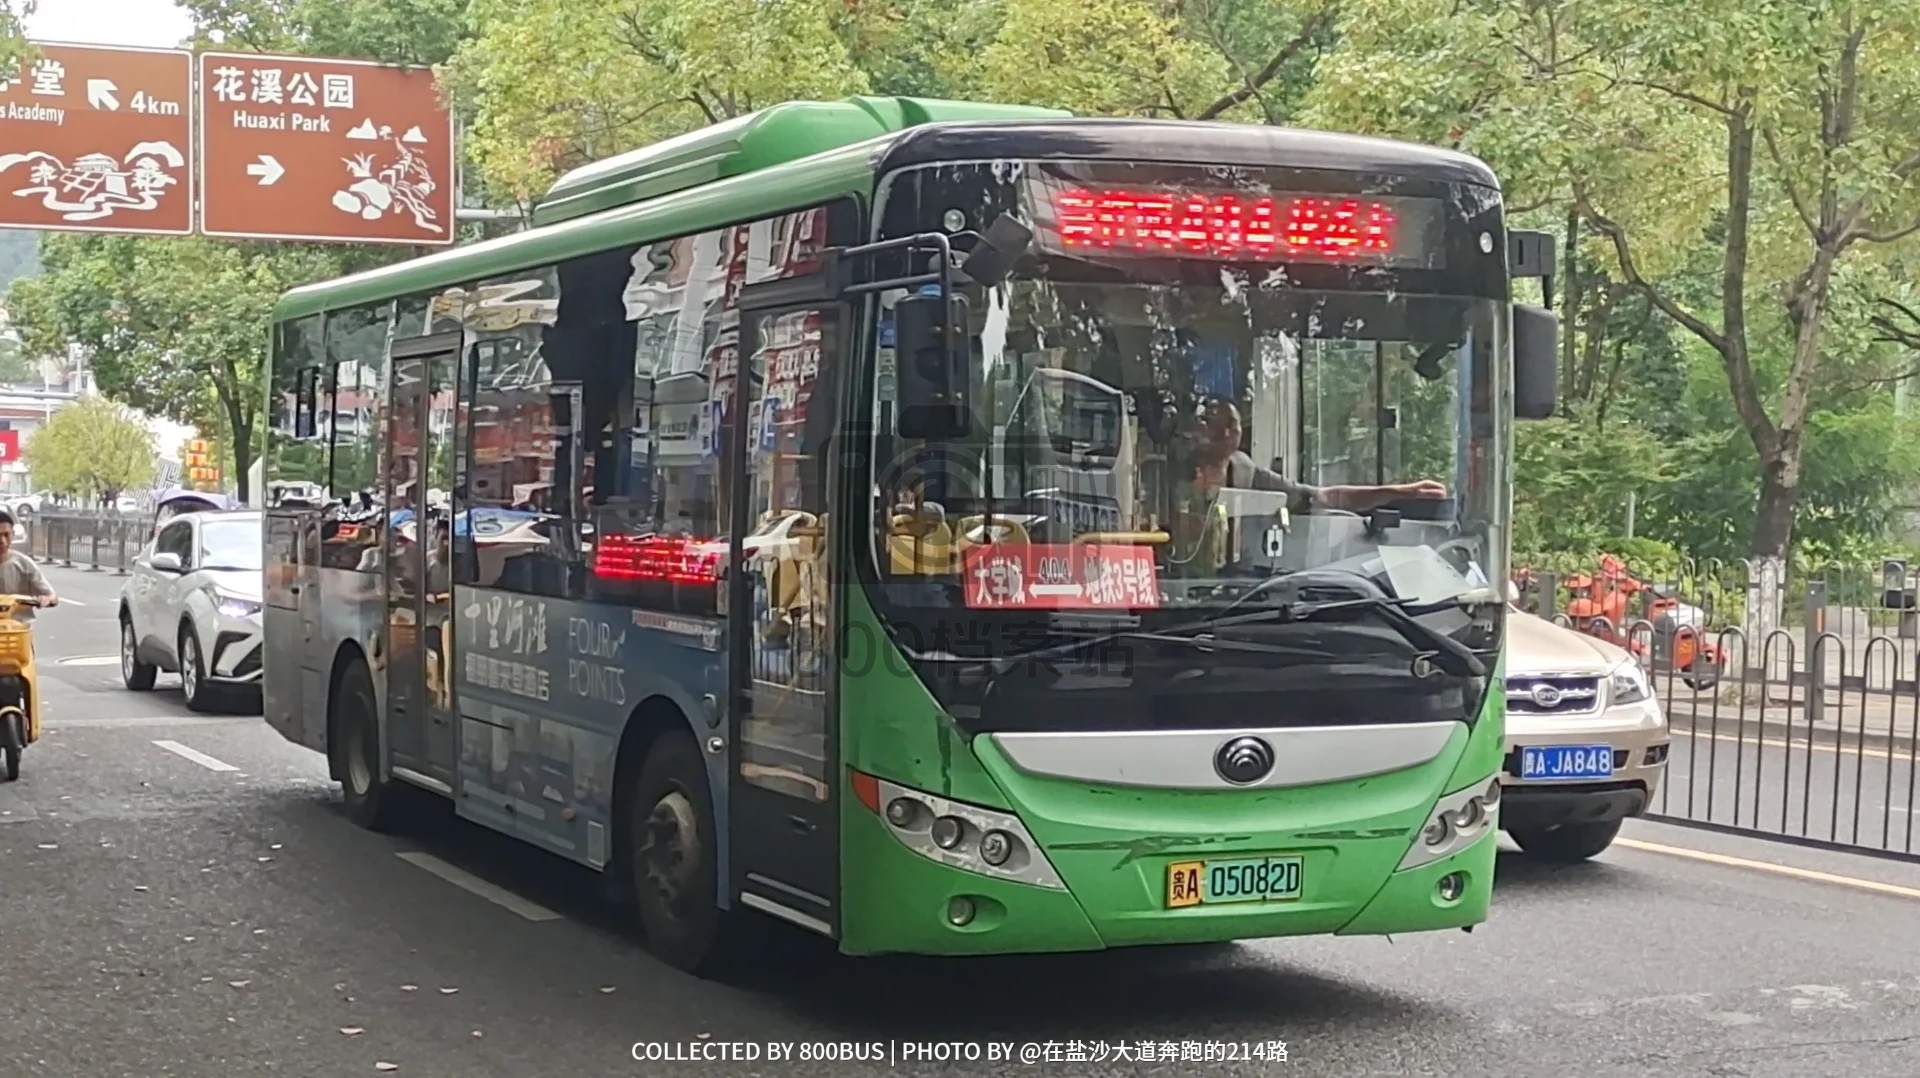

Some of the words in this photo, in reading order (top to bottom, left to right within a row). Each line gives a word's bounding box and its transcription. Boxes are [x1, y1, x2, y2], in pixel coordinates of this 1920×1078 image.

[131, 91, 179, 115] 4km
[212, 66, 355, 109] 花溪公园
[8, 101, 65, 126] Academy
[233, 110, 286, 131] Huaxi
[292, 113, 331, 133] Park
[1038, 556, 1073, 584] 404
[569, 617, 613, 659] FOUR
[569, 659, 626, 706] POINTS
[1211, 862, 1300, 897] 05082D
